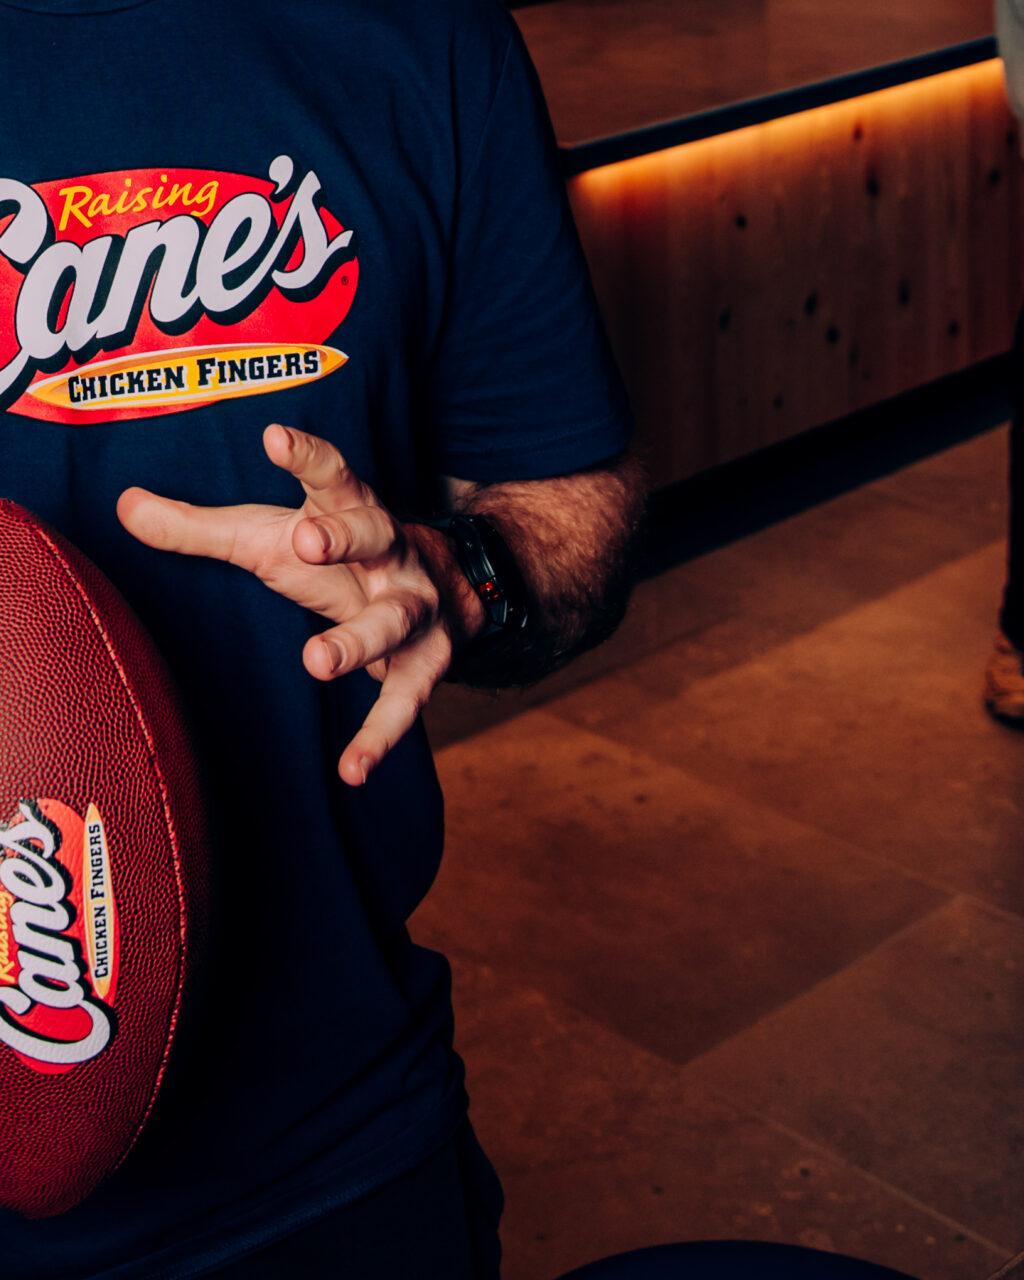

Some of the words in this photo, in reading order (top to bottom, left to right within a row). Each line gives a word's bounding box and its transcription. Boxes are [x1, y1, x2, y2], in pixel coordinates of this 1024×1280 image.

[58, 174, 220, 231] Raising
[67, 366, 185, 404] CHICKEN
[196, 350, 320, 392] FINGERS
[88, 822, 106, 902] FINGERS
[94, 904, 110, 980] CHICKEN
